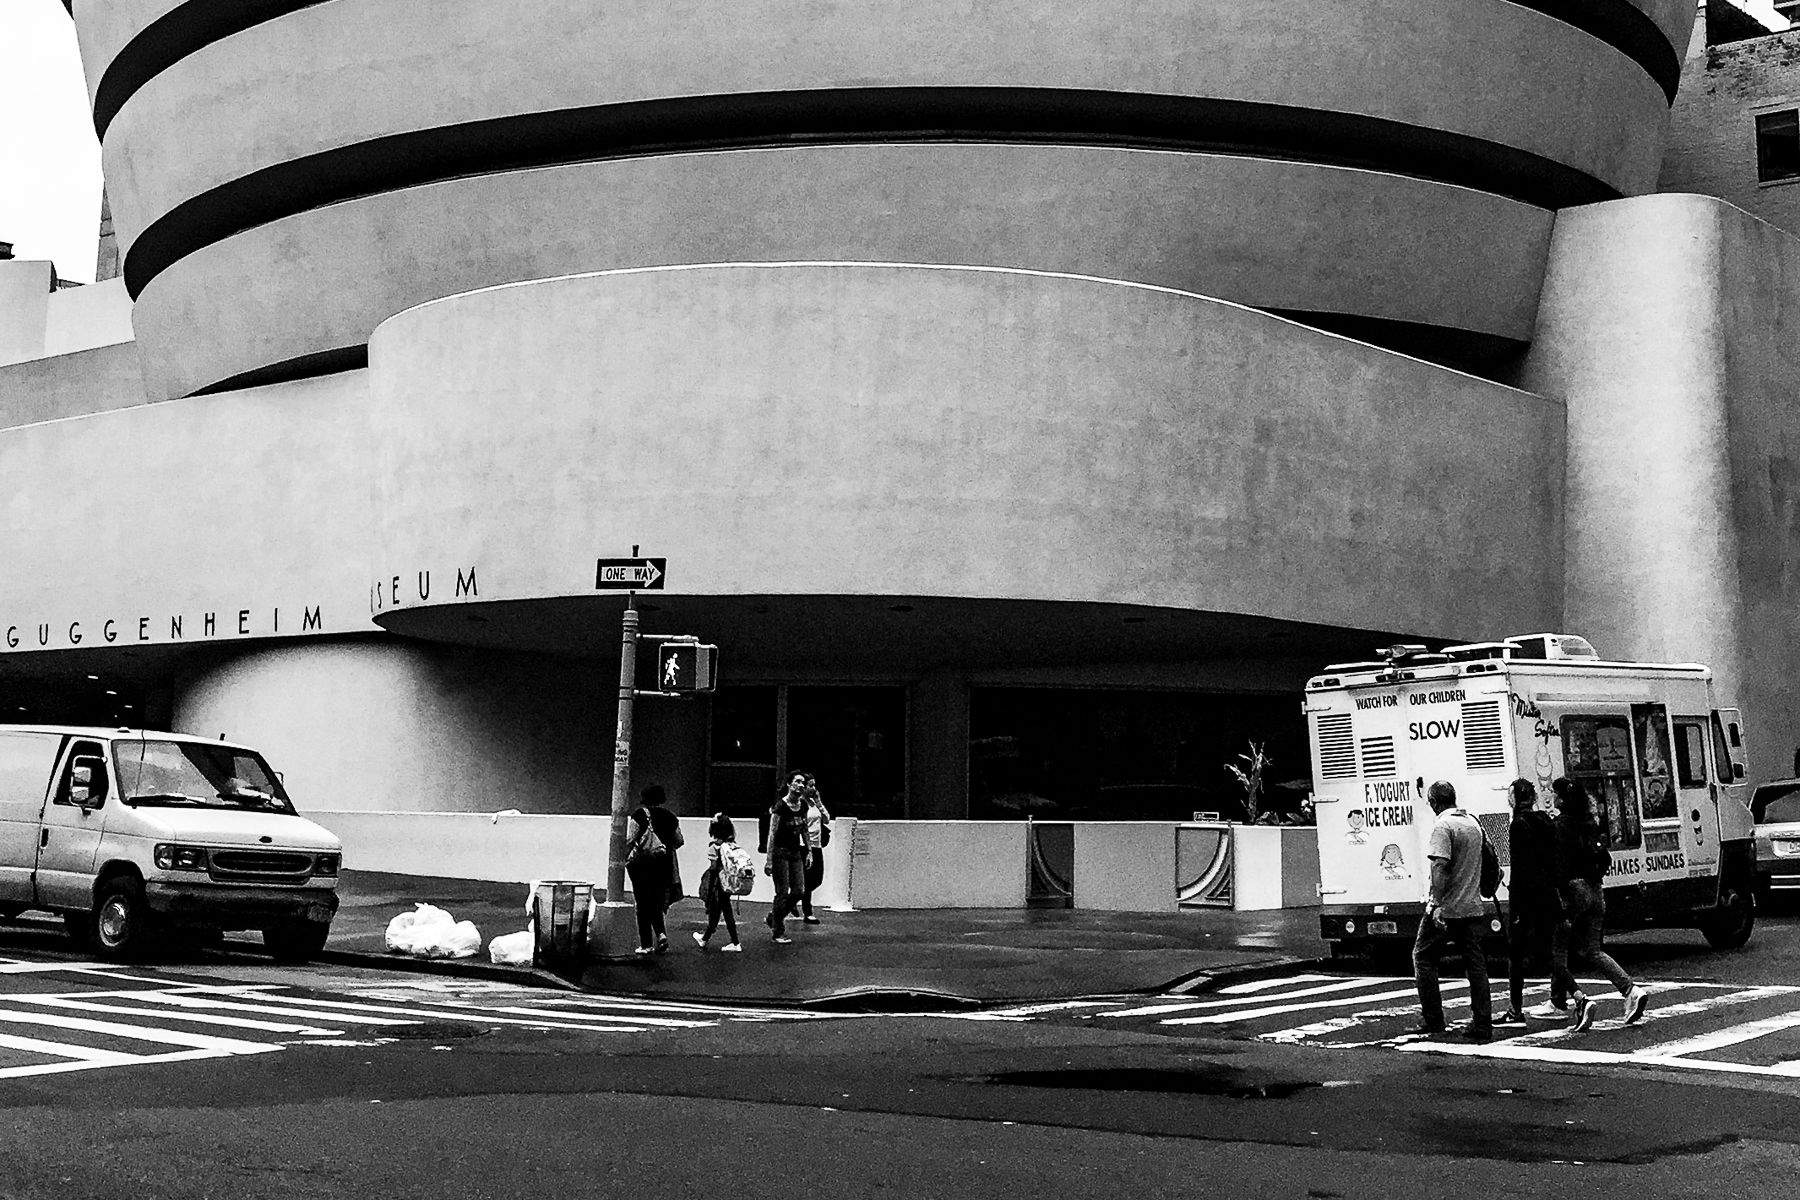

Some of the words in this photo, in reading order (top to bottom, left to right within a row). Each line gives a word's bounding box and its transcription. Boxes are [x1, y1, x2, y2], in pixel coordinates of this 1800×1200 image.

[606, 567, 626, 580] ONE
[634, 567, 655, 580] WAY
[6, 605, 322, 648] GUGGENHEIM
[1355, 695, 1380, 709] WATCH
[1383, 694, 1397, 706] FOR
[1409, 693, 1427, 705] OUR
[1428, 689, 1465, 703] CHILDREN
[1409, 719, 1460, 740] SLOW
[1373, 781, 1409, 802] YOGURT
[1364, 807, 1380, 827] ICE
[1382, 805, 1413, 826] CREAM
[1645, 852, 1685, 872] SUNDAES
